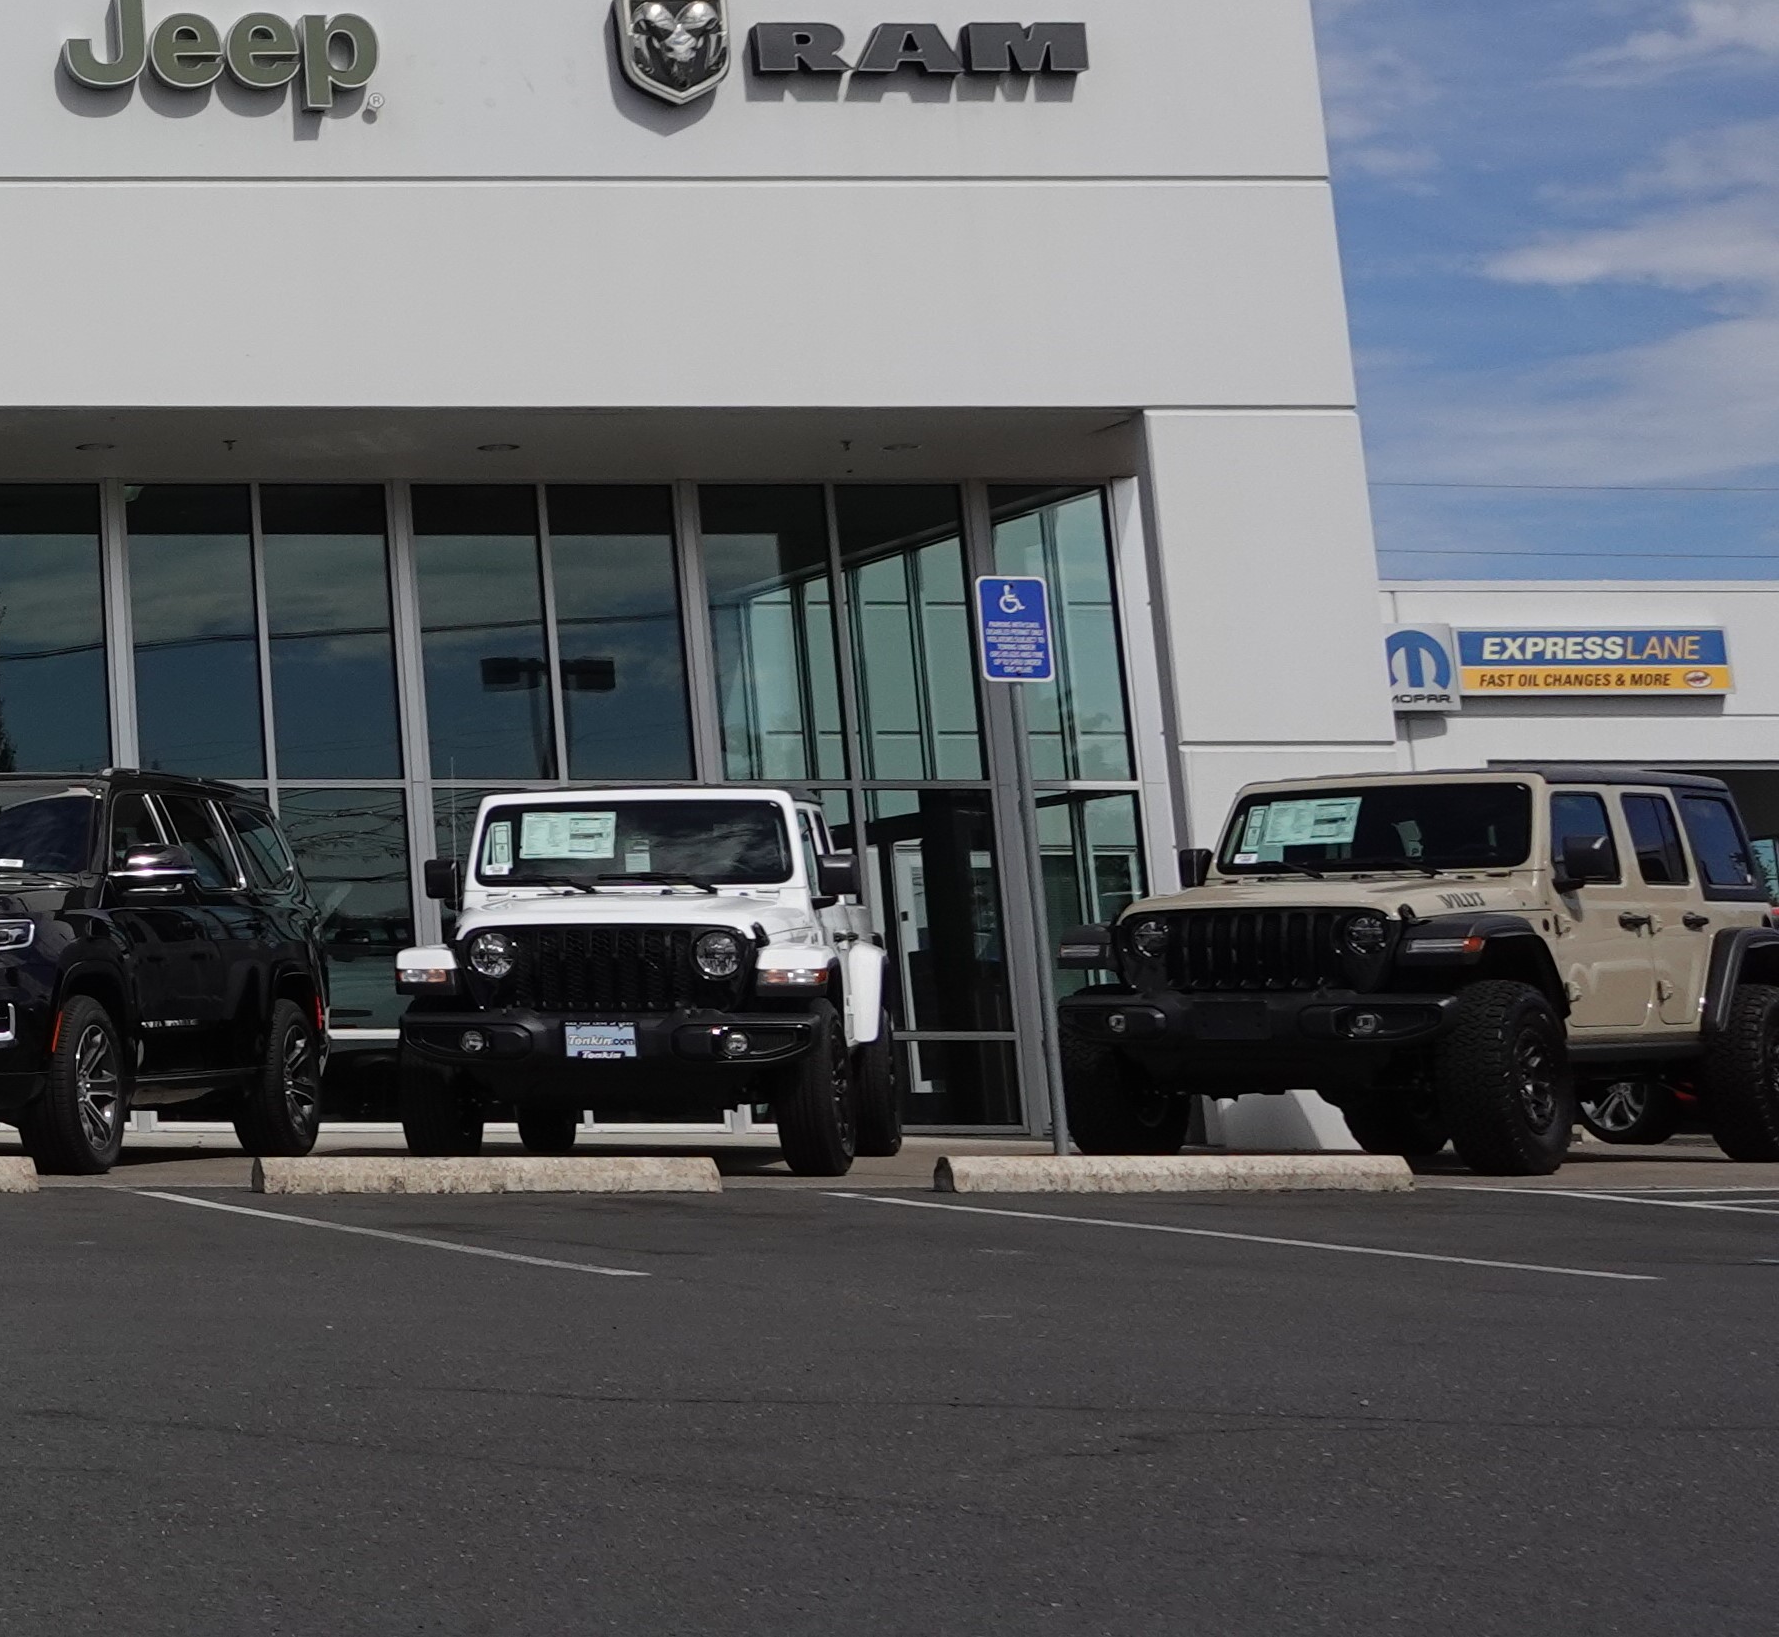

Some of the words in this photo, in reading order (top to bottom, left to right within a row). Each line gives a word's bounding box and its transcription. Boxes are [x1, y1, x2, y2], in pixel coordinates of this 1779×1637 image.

[744, 21, 1089, 74] RAM
[1479, 673, 1515, 687] FAST
[1518, 673, 1540, 687] OIL
[1543, 672, 1611, 686] CHANGES
[1614, 672, 1626, 686] &
[1629, 672, 1672, 686] MORE
[568, 1035, 635, 1046] Tonkin.com
[581, 1050, 623, 1059] Tonkin
